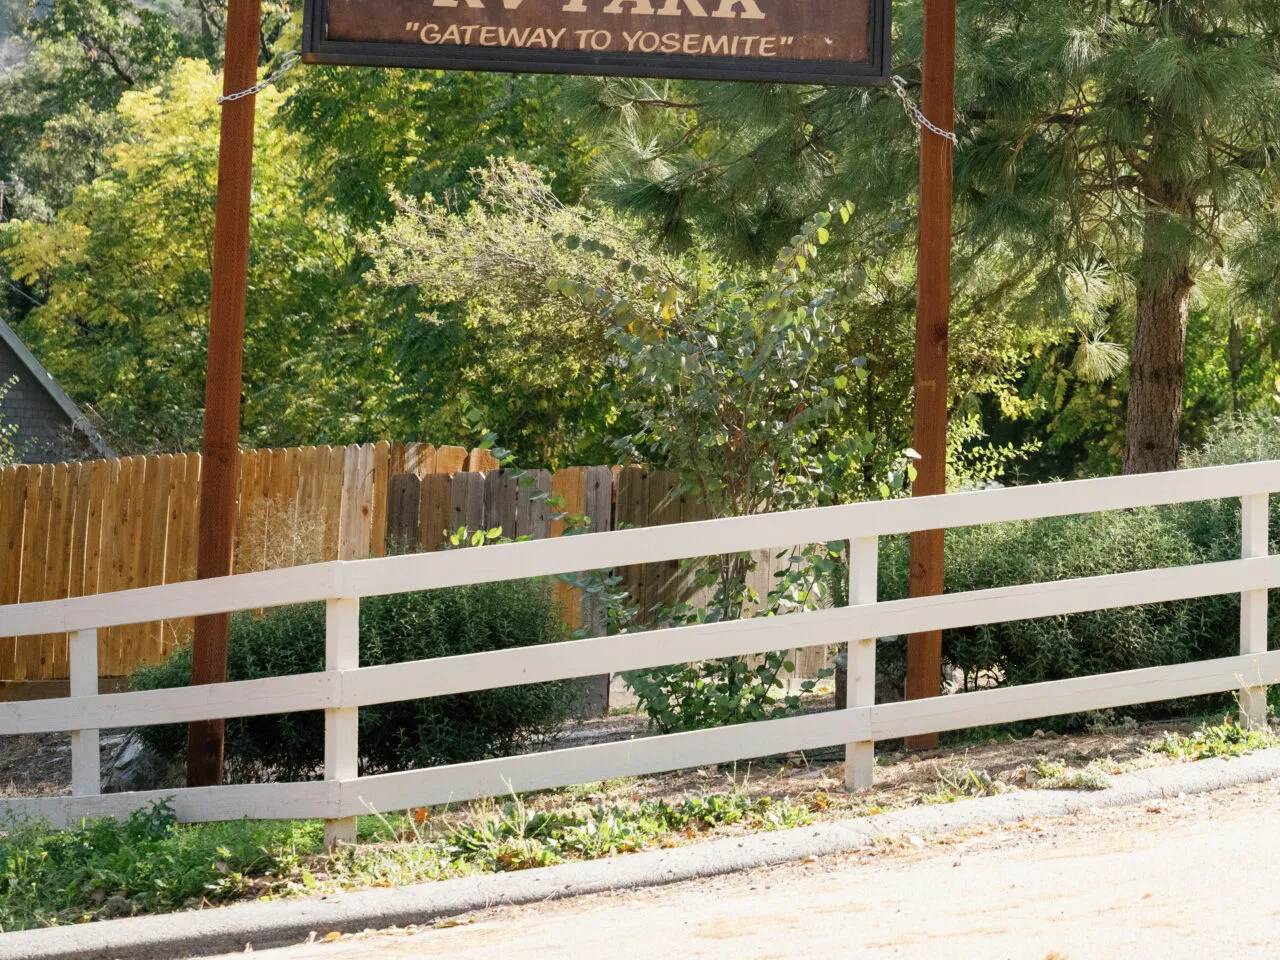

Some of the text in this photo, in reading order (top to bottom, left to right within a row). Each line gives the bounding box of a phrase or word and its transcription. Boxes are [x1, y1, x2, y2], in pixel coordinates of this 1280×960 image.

[405, 21, 794, 57] "GATEWAY TO YOSEMITE"
